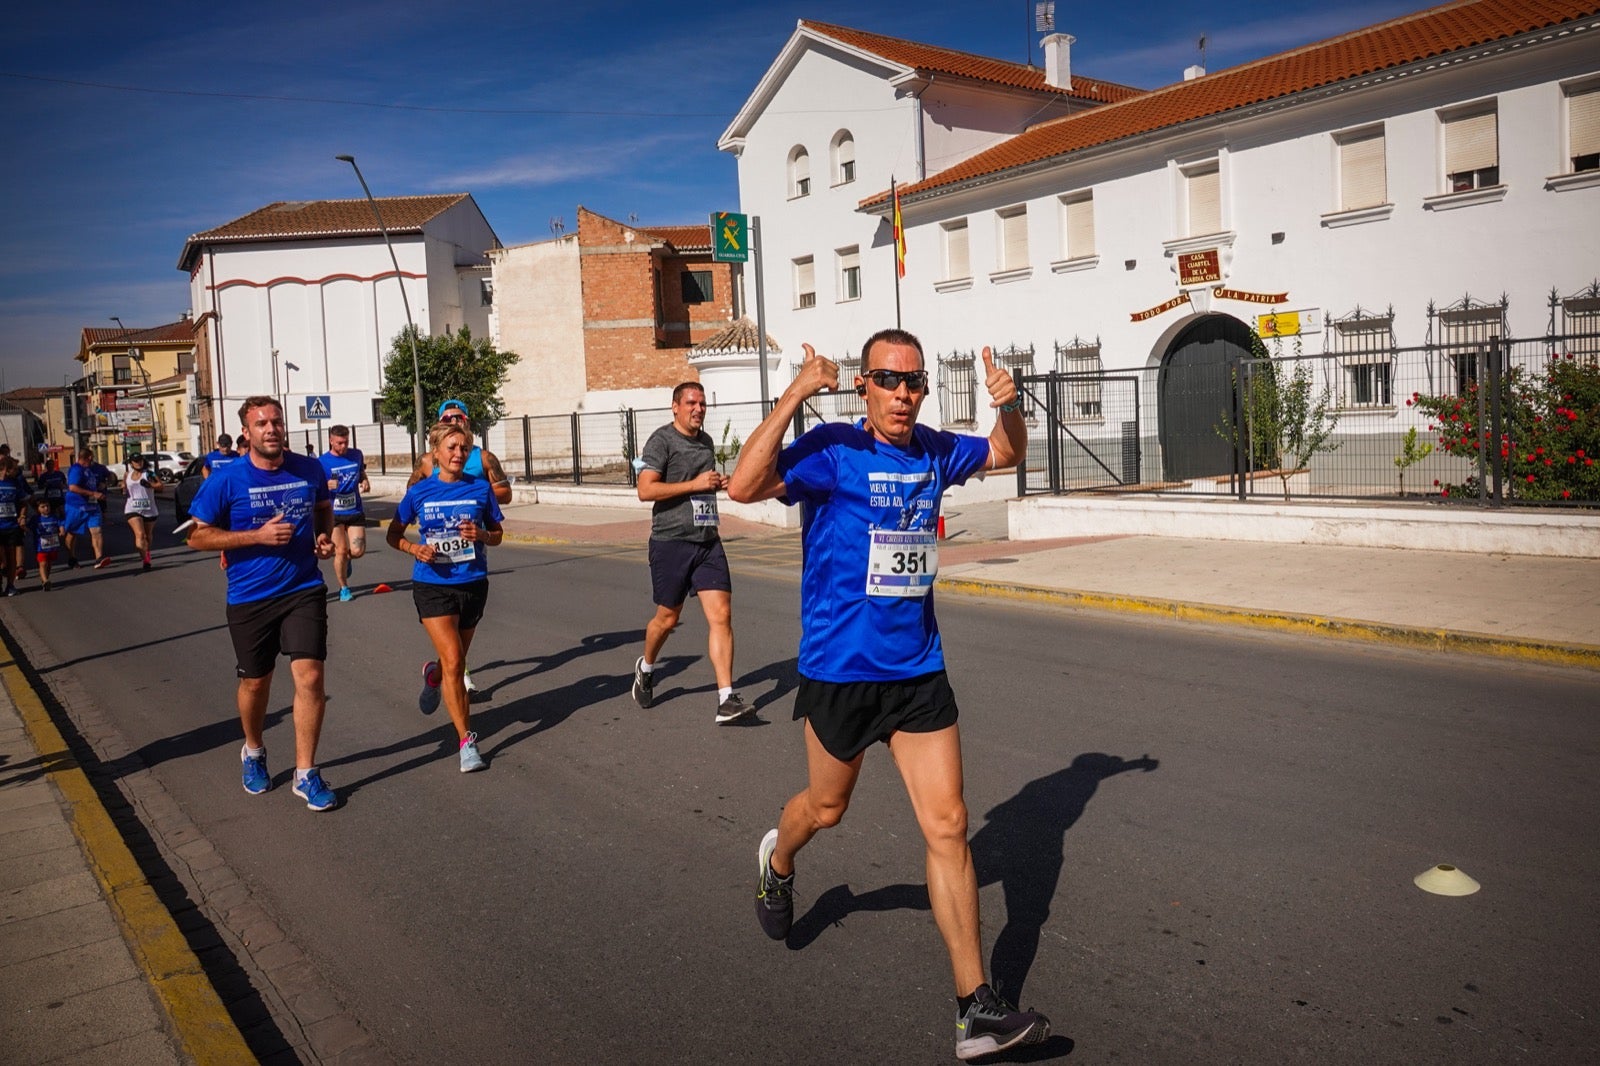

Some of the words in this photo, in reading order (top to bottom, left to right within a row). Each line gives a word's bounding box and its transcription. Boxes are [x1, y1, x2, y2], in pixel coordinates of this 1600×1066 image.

[1187, 260, 1211, 268] CUARTEL
[1140, 307, 1161, 320] TODO
[1166, 298, 1181, 308] POR
[1227, 290, 1238, 299] LA
[1244, 292, 1276, 303] PATRIA
[869, 483, 888, 494] VUELVE
[889, 483, 896, 494] LA
[869, 495, 891, 507] ESTELA
[434, 539, 469, 553] 1038
[891, 551, 927, 574] 351
